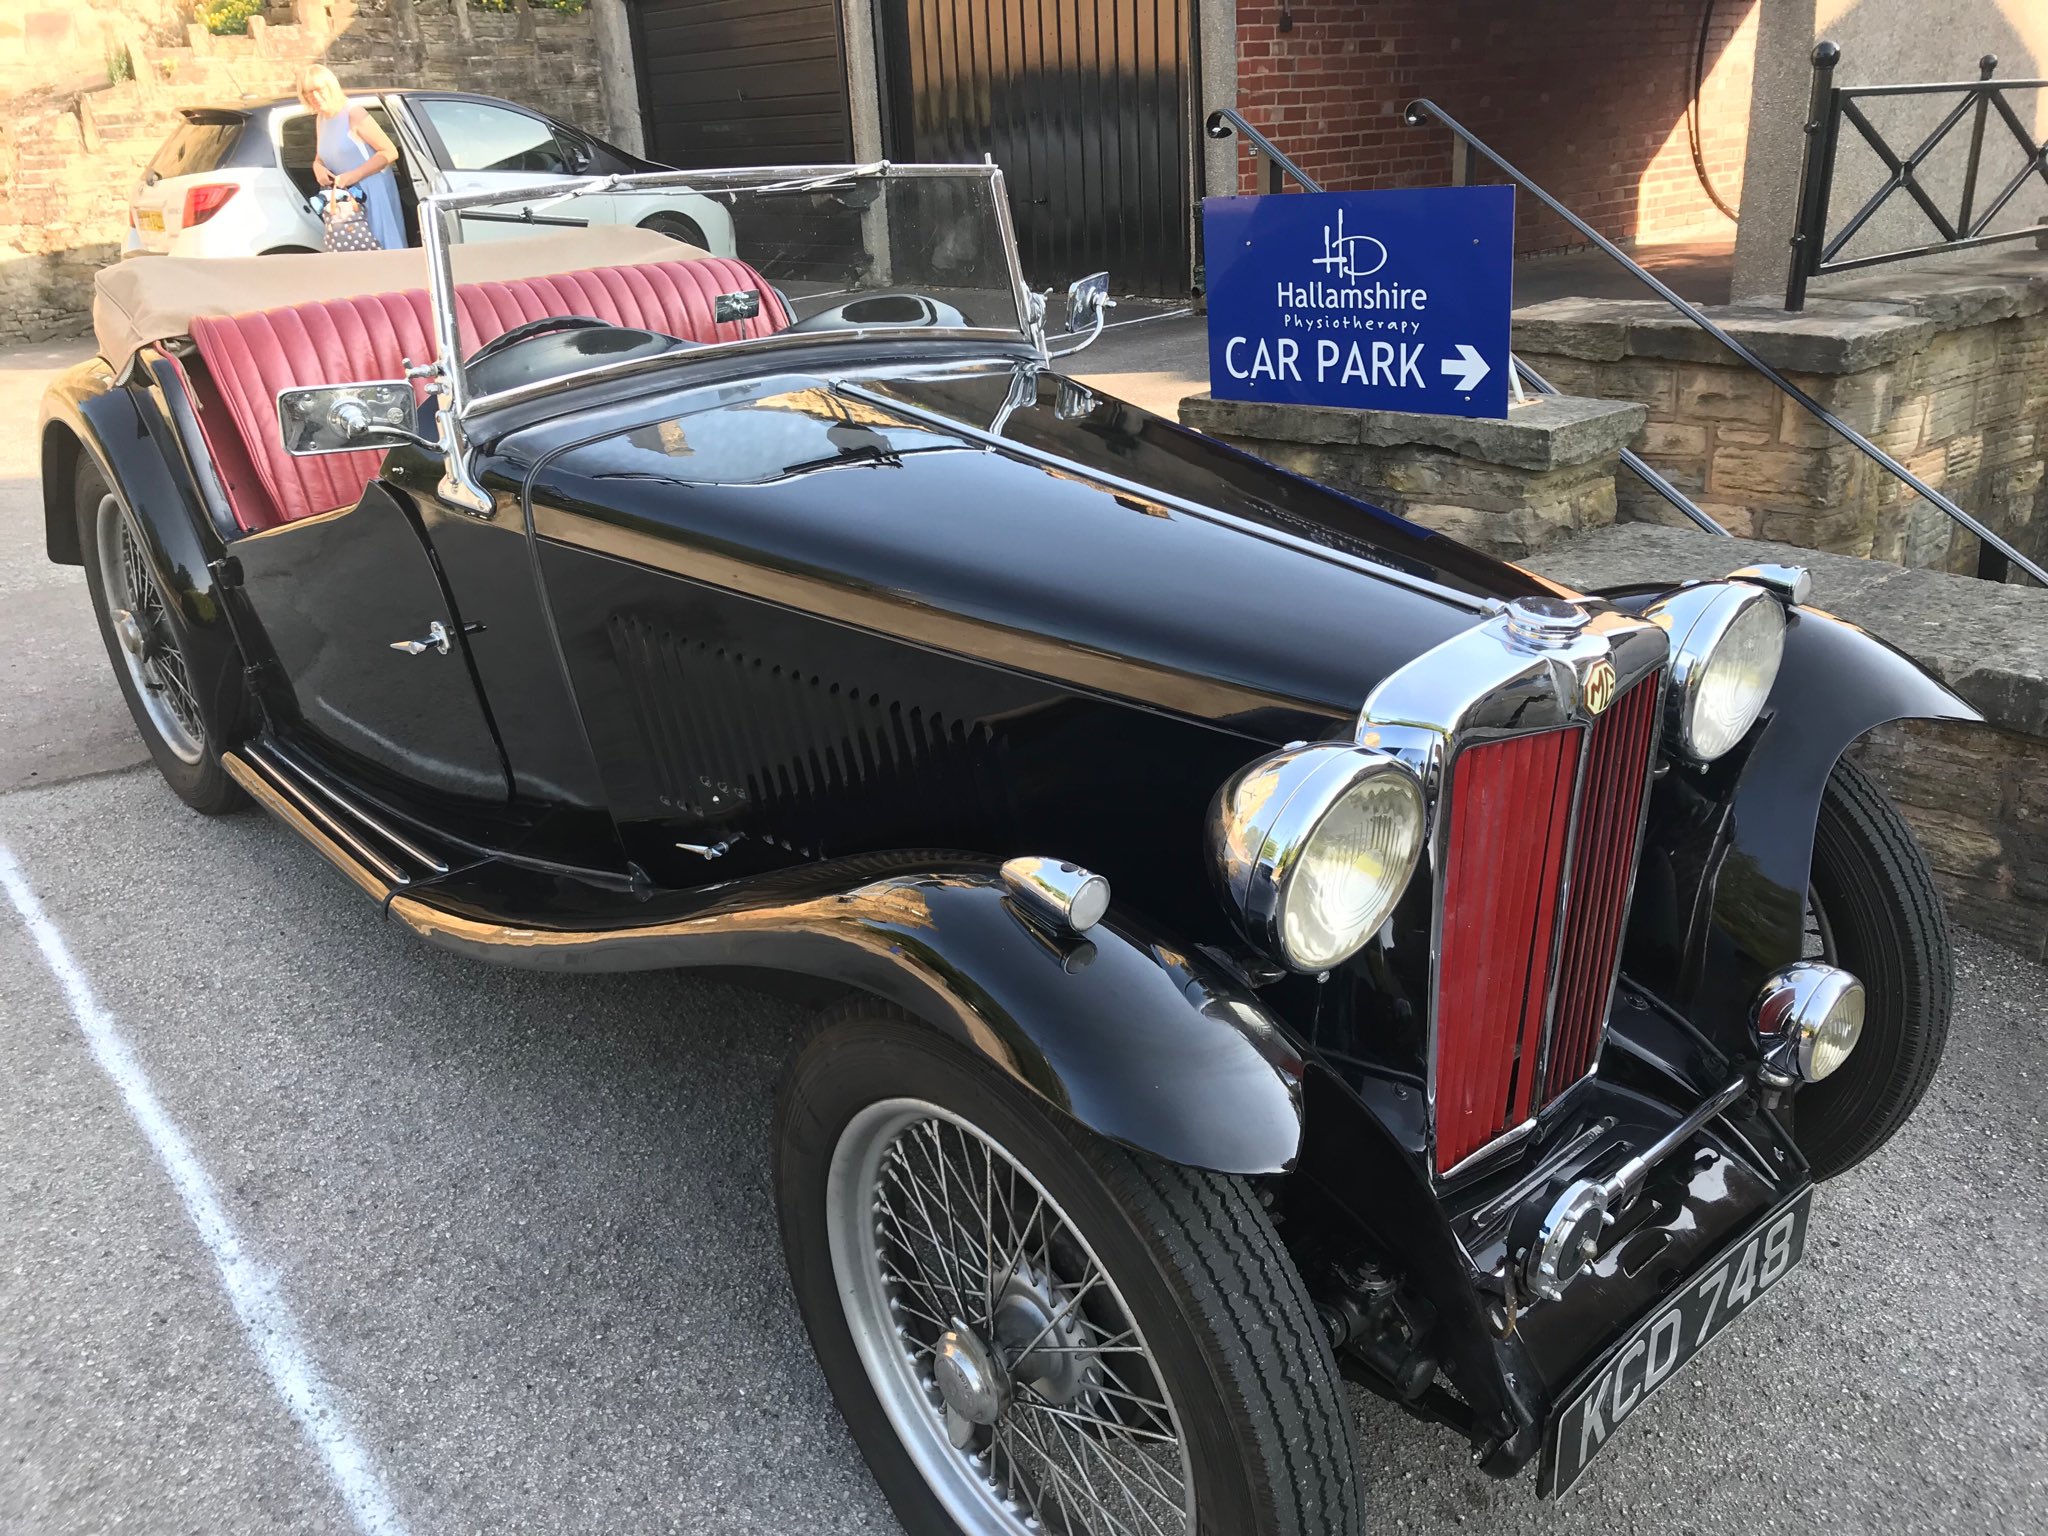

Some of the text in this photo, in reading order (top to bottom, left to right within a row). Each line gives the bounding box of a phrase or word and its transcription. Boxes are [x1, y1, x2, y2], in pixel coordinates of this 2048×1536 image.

[1277, 281, 1428, 311] Hallamshire
[1284, 313, 1420, 335] Physiotherapy
[1225, 336, 1427, 389] CAR PARK
[1590, 666, 1615, 710] MG
[1578, 1211, 1795, 1468] KCD 748
